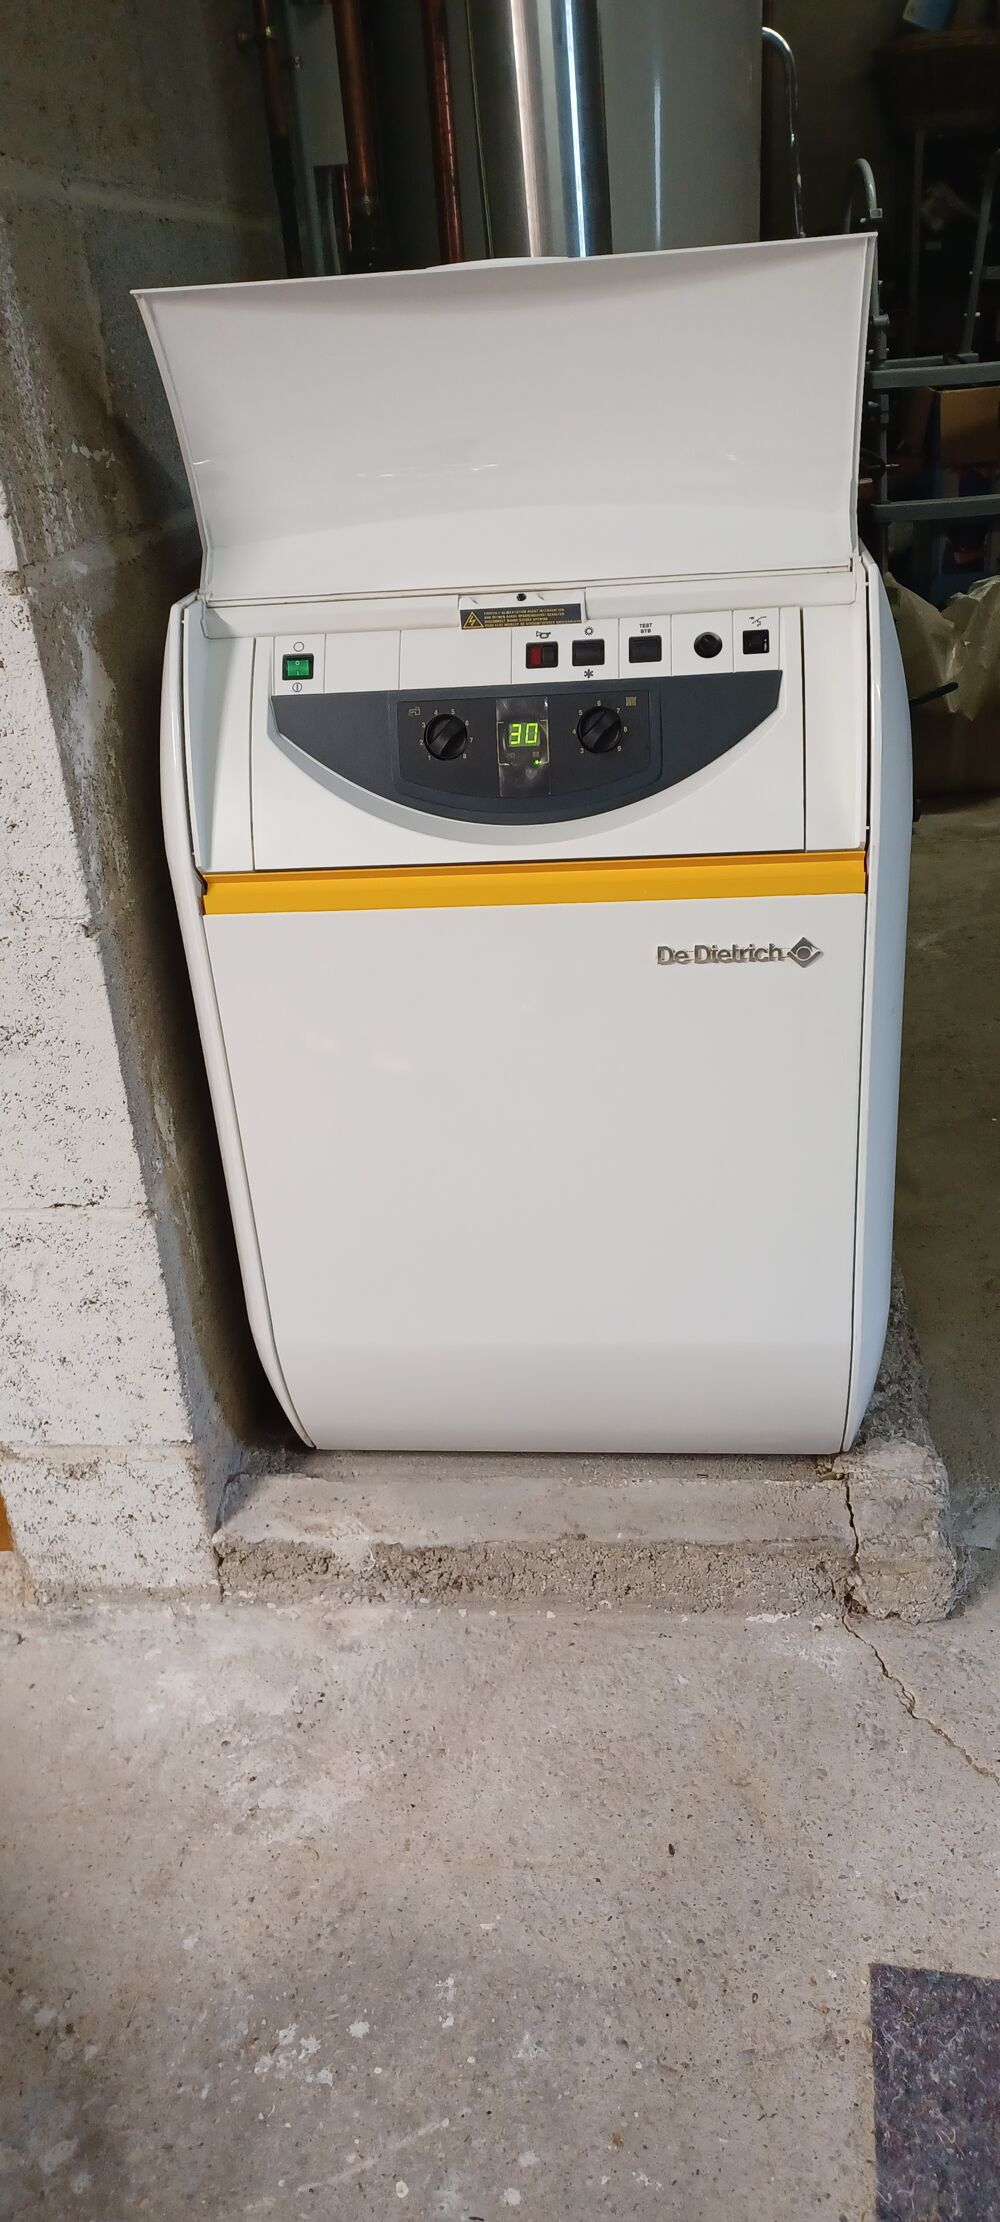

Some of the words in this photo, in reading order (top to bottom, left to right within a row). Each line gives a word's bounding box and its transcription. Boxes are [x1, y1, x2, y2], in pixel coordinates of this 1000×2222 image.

[510, 723, 538, 745] 30
[657, 946, 690, 965] De
[695, 943, 785, 964] Dietrich
